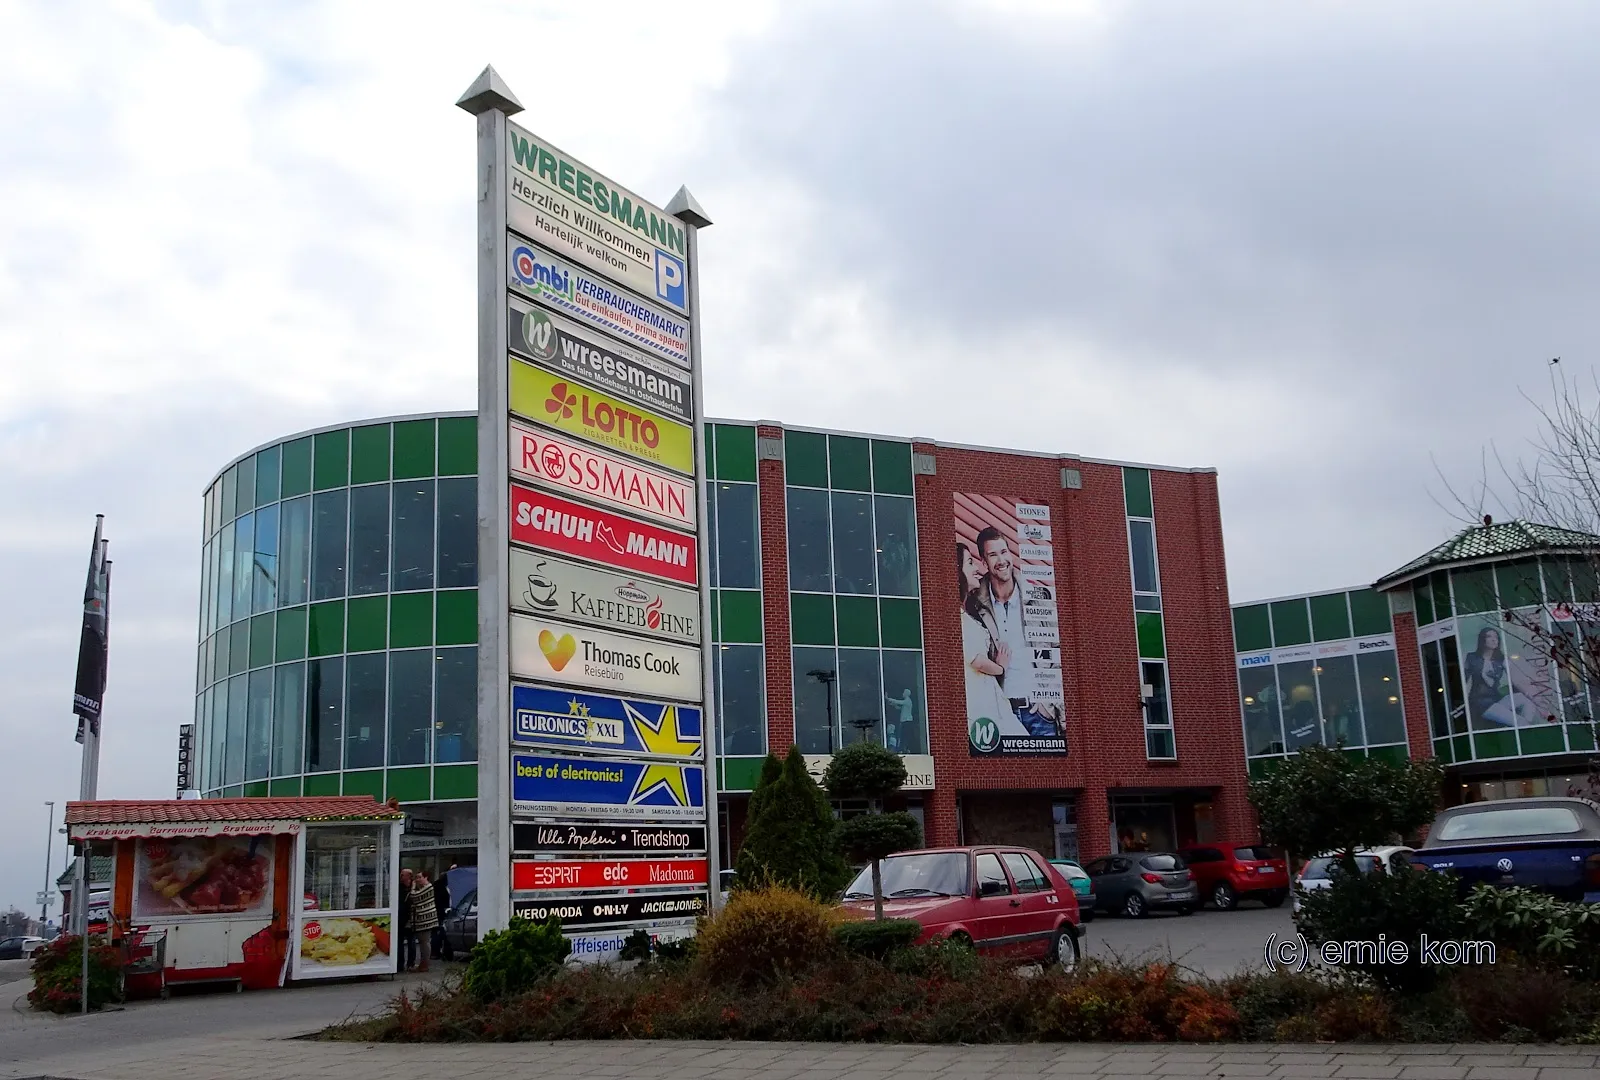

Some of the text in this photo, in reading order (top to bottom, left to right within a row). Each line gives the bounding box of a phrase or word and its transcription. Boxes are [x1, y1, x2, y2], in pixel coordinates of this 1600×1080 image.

[510, 130, 684, 255] WREESMANN
[512, 177, 650, 263] Herzlich Willkommen
[535, 215, 628, 272] Hartelijk welkom
[512, 246, 569, 294] Combi
[659, 255, 682, 298] P
[576, 275, 685, 339] VERBRAUCHERMARKT
[575, 292, 687, 352] Gut einkaufen, prima sparen!
[560, 336, 682, 404] wreesmann
[561, 358, 684, 415] Das faire Modehaus in Ostrhauderfehn
[582, 394, 660, 449] LOTTO
[583, 427, 628, 449] ZIGARETTEN
[635, 446, 660, 460] PRESSE
[522, 435, 686, 517] ROSSMANN
[1019, 507, 1046, 516] STONES
[516, 501, 688, 567] SCHUH MANN
[618, 587, 648, 601] Hoppmann
[571, 591, 694, 637] KAFFEEBOHNE
[1026, 608, 1052, 616] ROADSIGN
[581, 640, 680, 676] Thomas Cook
[1241, 655, 1271, 665] mavi
[1359, 640, 1390, 649] Bench.
[584, 665, 624, 681] Reisebüro
[76, 694, 99, 710] mann
[521, 714, 619, 738] EURONICS XXL
[1003, 739, 1065, 748] wreesmann
[516, 761, 624, 782] best of electronics!
[905, 774, 932, 786] HNE
[86, 828, 136, 836] Krakauer
[150, 826, 209, 835] Currywurst
[223, 825, 275, 833] Bratwurst
[537, 826, 565, 845] Ulla
[631, 829, 690, 849] Trendshop
[534, 862, 695, 885] ESPRIT edc Madonna
[516, 908, 547, 919] VERO
[549, 906, 582, 918] MODA
[641, 902, 666, 913] JACK
[674, 899, 702, 911] JONES
[303, 925, 321, 936] STOP
[573, 936, 624, 954] iffeisenb
